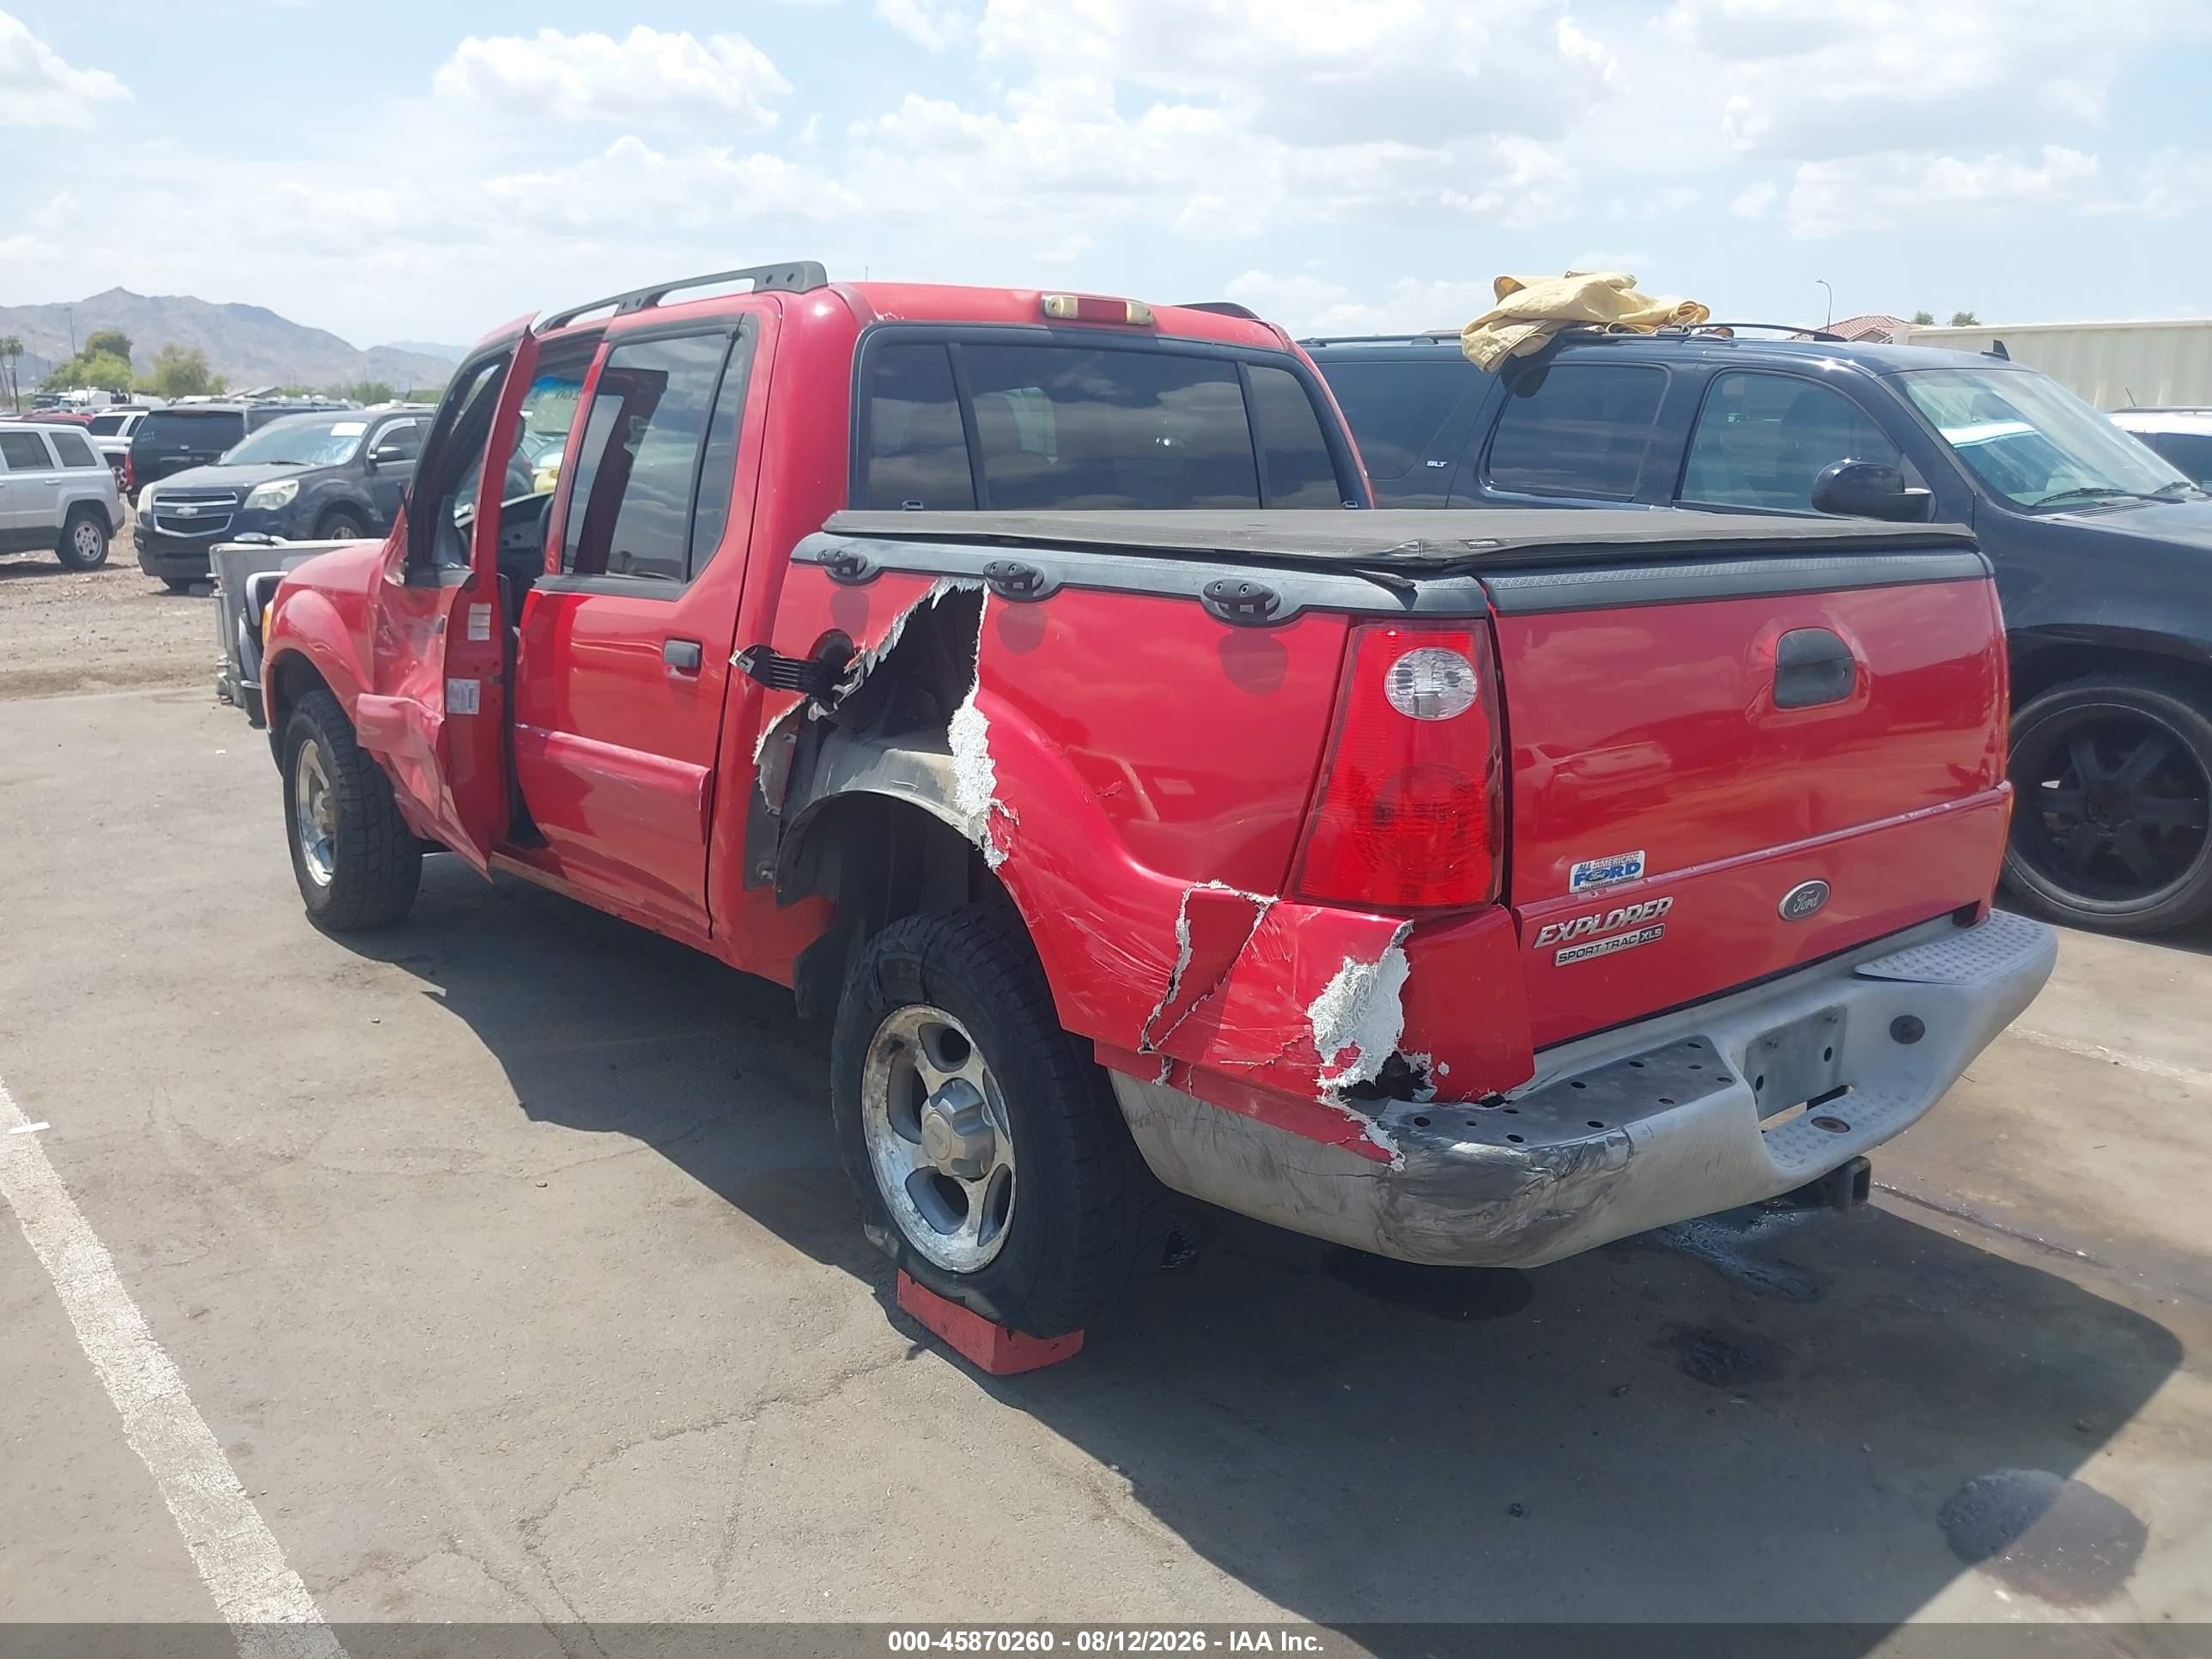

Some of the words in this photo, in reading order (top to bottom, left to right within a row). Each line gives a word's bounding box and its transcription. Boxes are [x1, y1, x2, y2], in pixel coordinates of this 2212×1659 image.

[1573, 861, 1641, 887] FORD
[1576, 862, 1593, 874] ALL
[1593, 852, 1640, 871] AMERICAN
[1793, 890, 1820, 914] Ford
[1533, 896, 1674, 949] EXPLORER
[1558, 944, 1602, 963] SPORT
[1604, 935, 1638, 951] TRAC
[1639, 928, 1663, 942] XLS
